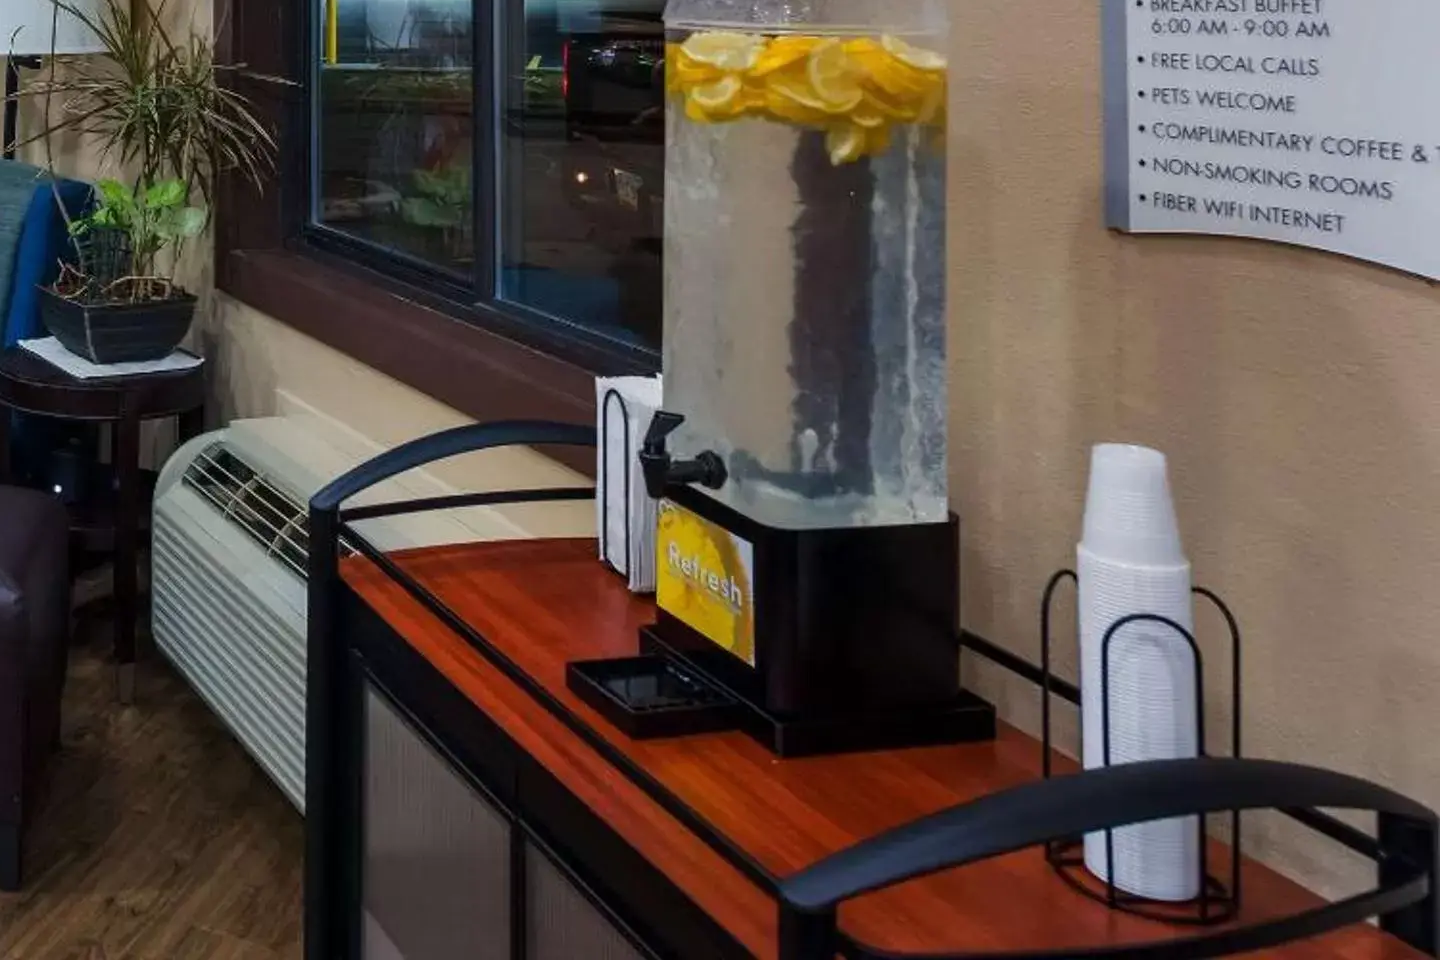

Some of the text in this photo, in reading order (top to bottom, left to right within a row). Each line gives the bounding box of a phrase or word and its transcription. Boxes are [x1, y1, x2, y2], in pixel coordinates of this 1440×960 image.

[1151, 18, 1191, 35] 6:00
[1196, 18, 1228, 35] AM
[1244, 19, 1289, 38] 9:00
[1295, 21, 1331, 38] AM
[1151, 52, 1320, 76] FREE LOCAL CALLS
[1152, 87, 1296, 113] PETS WELCOME
[1152, 121, 1313, 153] COMPLIMENTARY
[1320, 136, 1403, 161] COFFEE
[1410, 144, 1428, 163] &
[1152, 157, 1393, 201] NON-SMOKING ROOMS
[1153, 191, 1345, 233] FIBER WIFI INTERNET
[668, 542, 742, 607] Refresh
